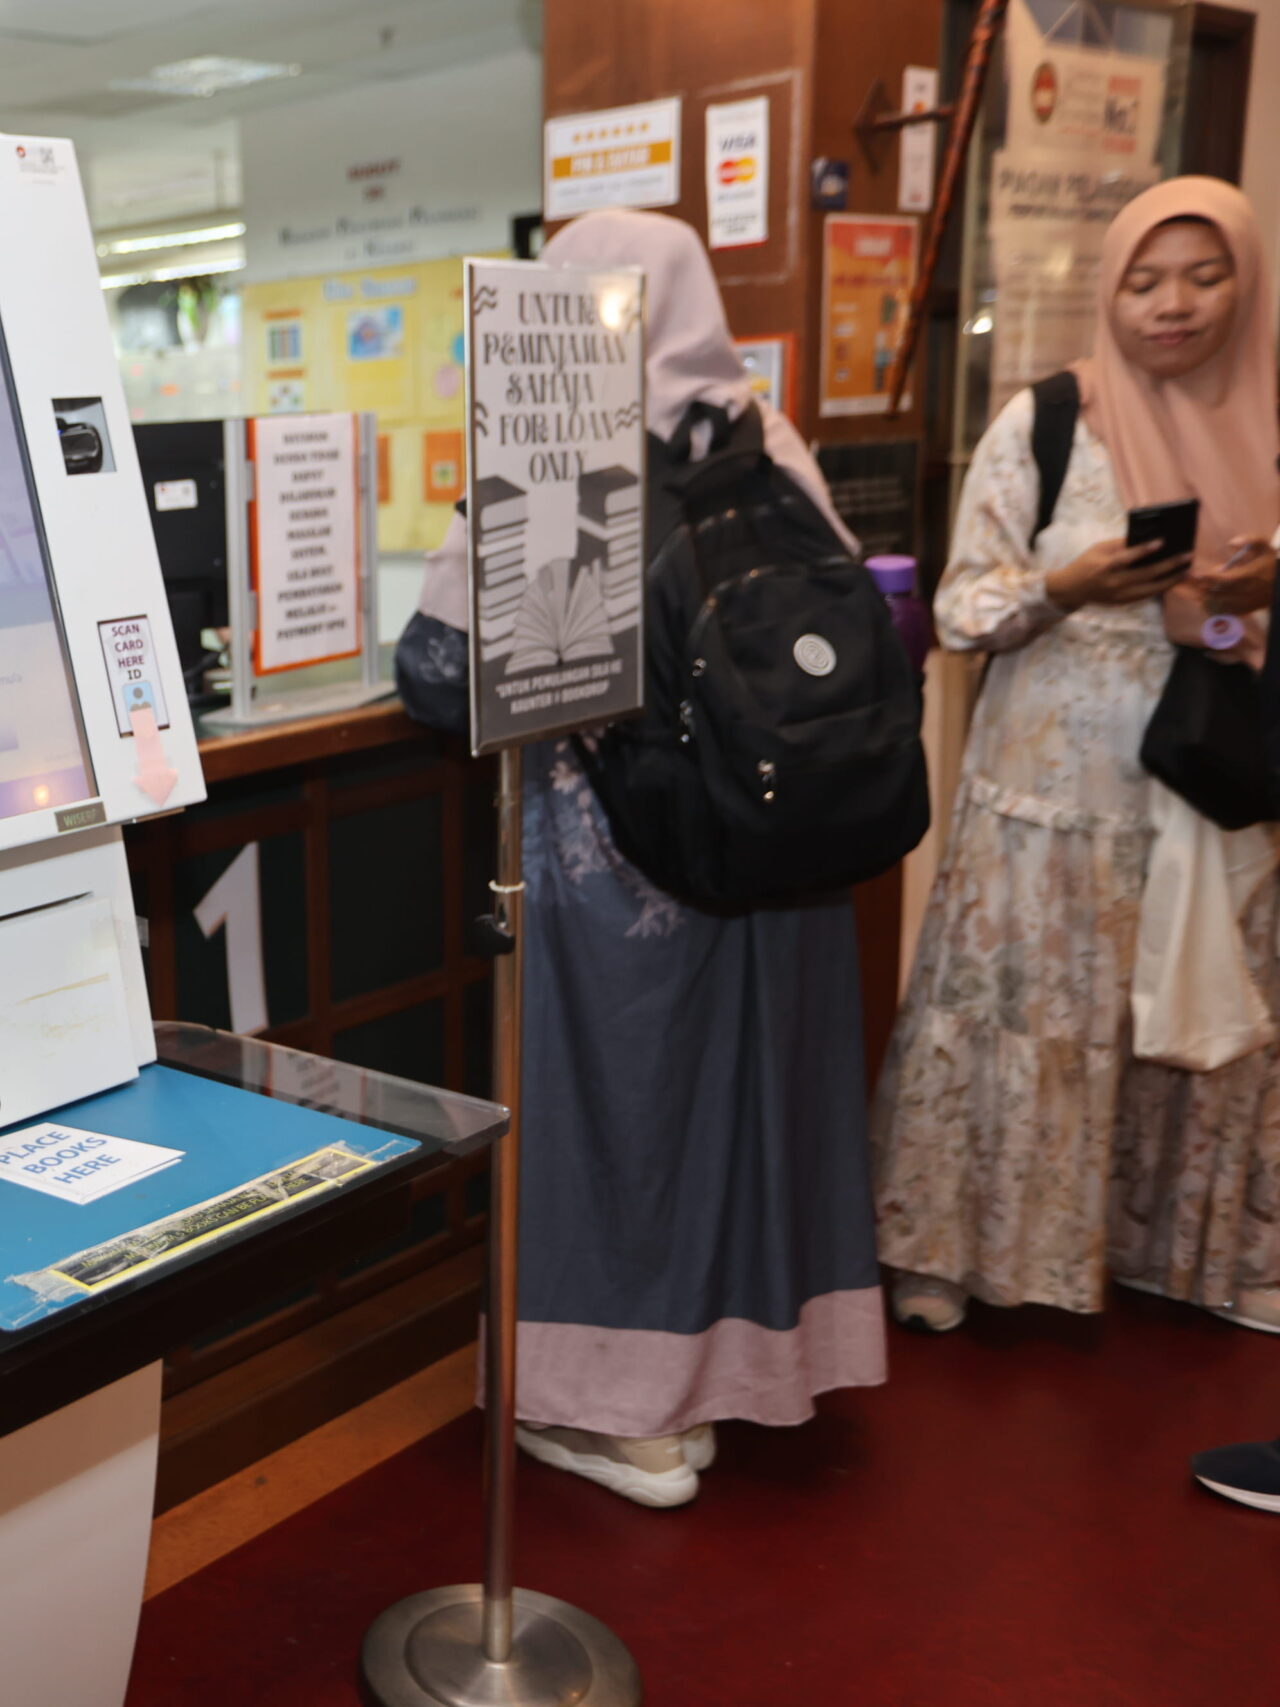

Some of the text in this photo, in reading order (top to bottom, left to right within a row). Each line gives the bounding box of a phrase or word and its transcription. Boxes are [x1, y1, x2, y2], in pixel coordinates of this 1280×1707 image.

[505, 372, 595, 414] SAHAJA
[499, 410, 614, 446] FOR LOAN
[529, 451, 586, 484] ONLY
[111, 623, 141, 637] SCAN
[114, 640, 144, 653] CARD
[117, 654, 145, 668] HERE
[127, 669, 142, 680] ID
[193, 841, 270, 1035] 1
[22, 1136, 108, 1175] BOOKS
[53, 1153, 122, 1184] HERE
